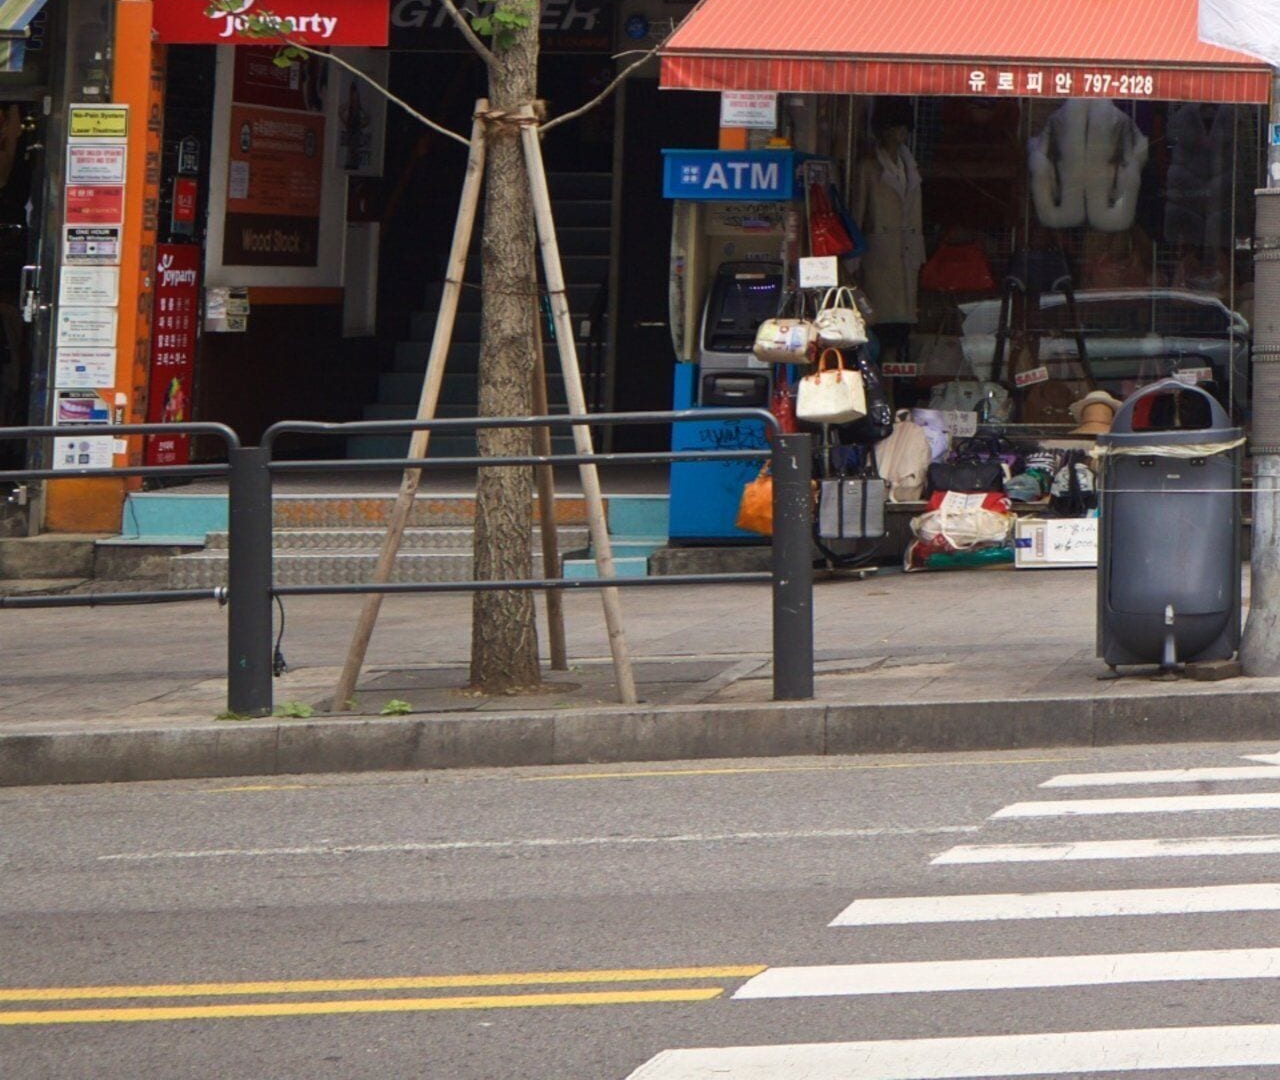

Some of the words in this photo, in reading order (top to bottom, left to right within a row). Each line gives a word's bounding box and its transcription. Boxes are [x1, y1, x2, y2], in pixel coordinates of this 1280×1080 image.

[1083, 73, 1153, 95] 797-2128
[703, 163, 779, 190] ATM
[884, 365, 916, 376] SALE
[1015, 370, 1047, 386] SALE
